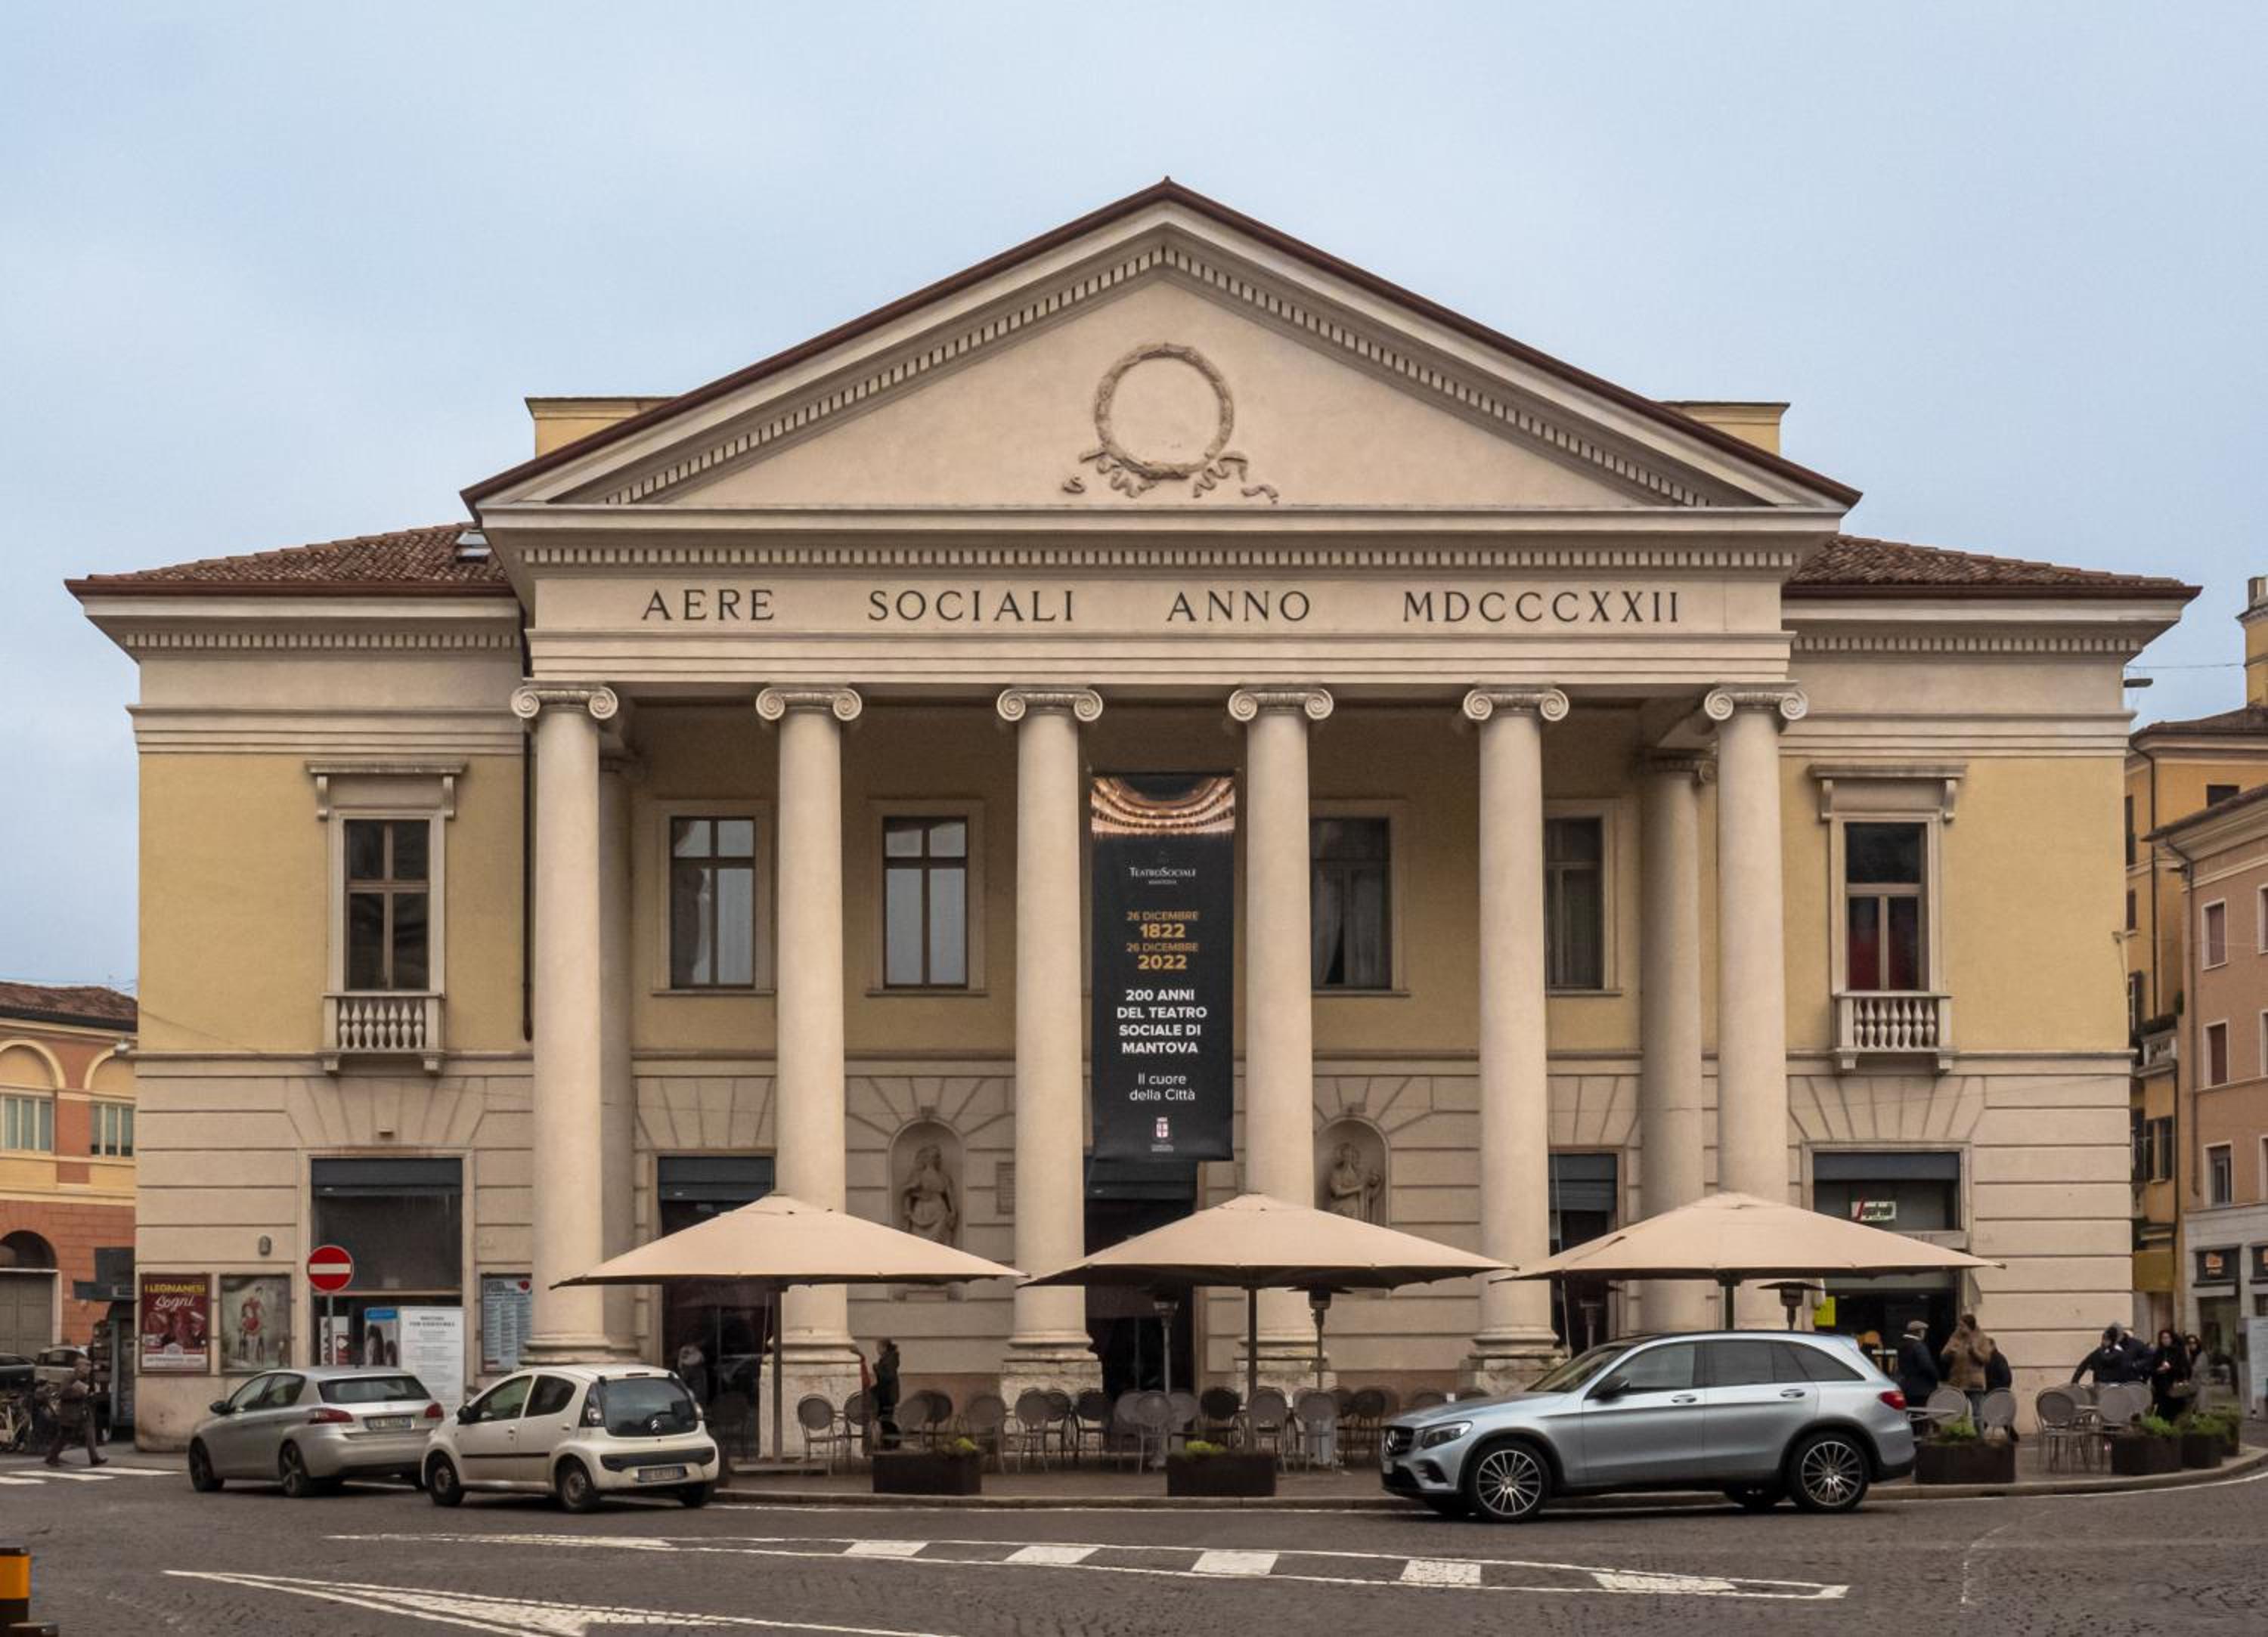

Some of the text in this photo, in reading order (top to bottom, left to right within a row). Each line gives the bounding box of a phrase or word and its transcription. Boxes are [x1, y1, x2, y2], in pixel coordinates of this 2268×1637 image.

[642, 589, 1679, 623] AERE SOCIALI ANNO MDCCCXXII
[1126, 911, 1199, 921] 26 DICEMBRE
[1139, 923, 1186, 939] 1822
[1126, 942, 1199, 952] 26 DICEMBRE
[1138, 954, 1187, 970] 2022
[1125, 989, 1195, 1001] 200 ANNI
[1117, 1006, 1208, 1020] DEL TEATRO
[1118, 1023, 1201, 1037] SOCIALE DI
[1121, 1041, 1199, 1054] MANTOVA
[1138, 1072, 1187, 1085] Il cuore
[1129, 1087, 1195, 1101] della Città
